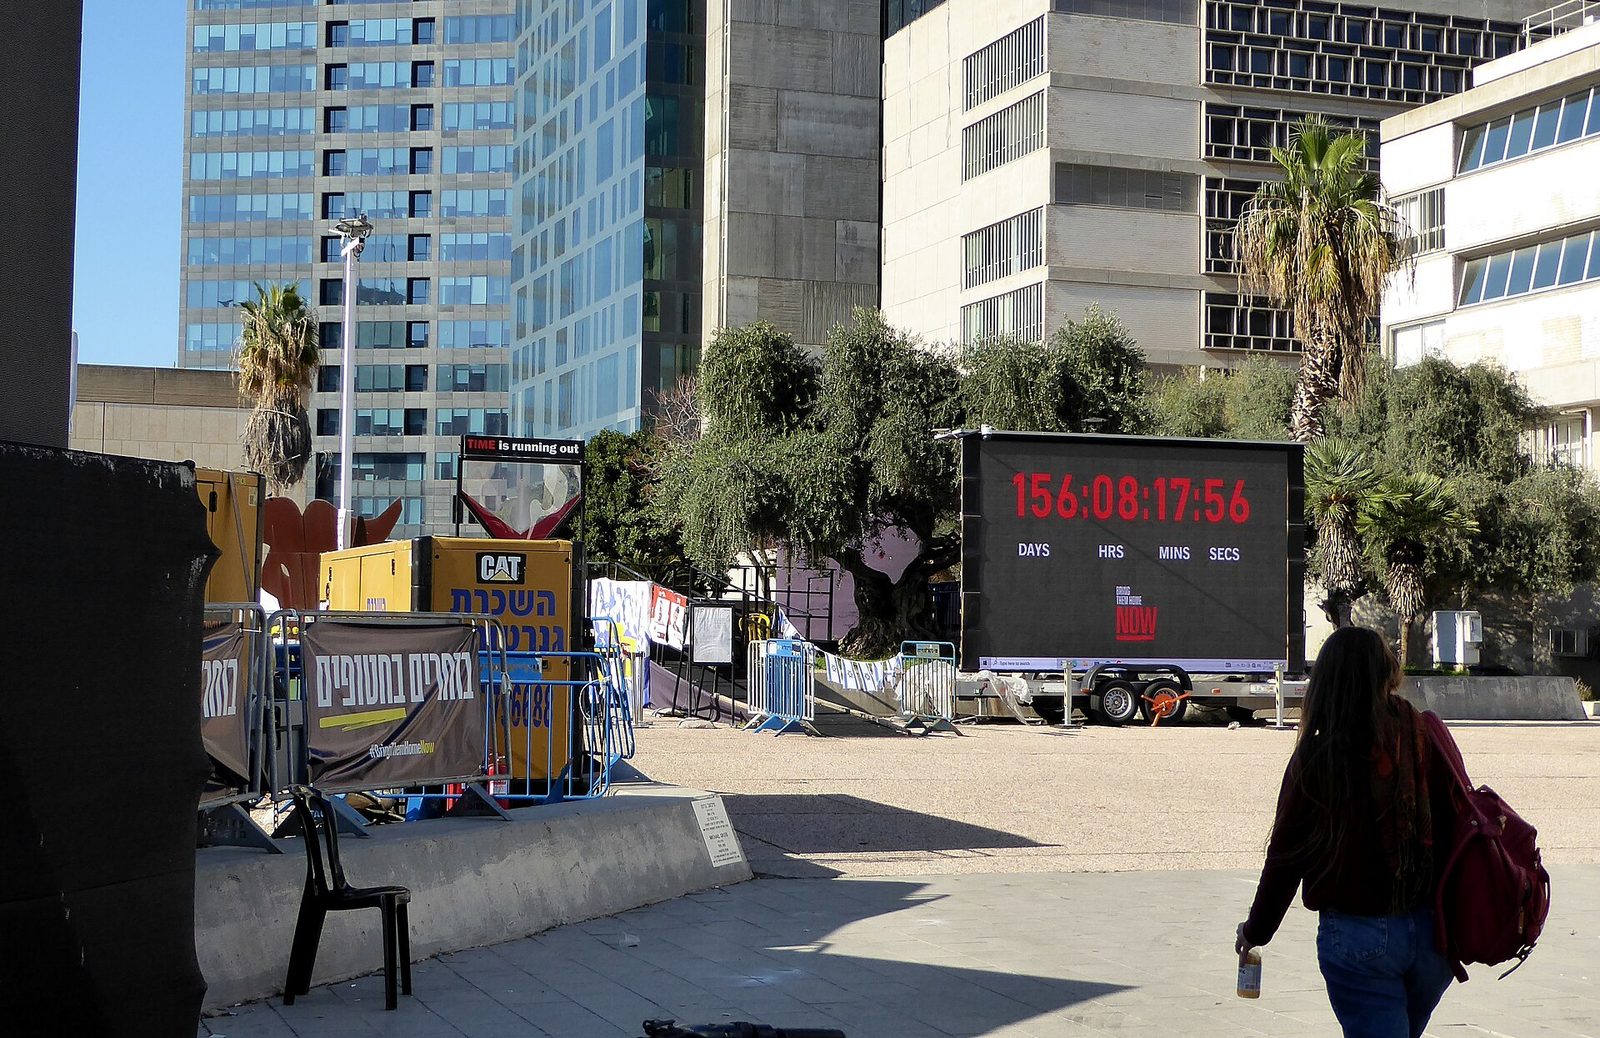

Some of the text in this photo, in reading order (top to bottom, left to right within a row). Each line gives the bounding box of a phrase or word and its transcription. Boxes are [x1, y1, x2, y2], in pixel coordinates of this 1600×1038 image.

[467, 439, 580, 455] TIME is running out
[1013, 472, 1250, 524] 156:08:17:56
[1018, 542, 1240, 561] DAYS HRS MINS SECS
[481, 555, 521, 581] CAT
[451, 588, 556, 616] השכרת
[1116, 606, 1158, 634] NOW
[202, 658, 238, 717] בוחר
[315, 652, 474, 707] בוחרים בחטופים
[369, 739, 435, 760] #BringThemHomeNow
